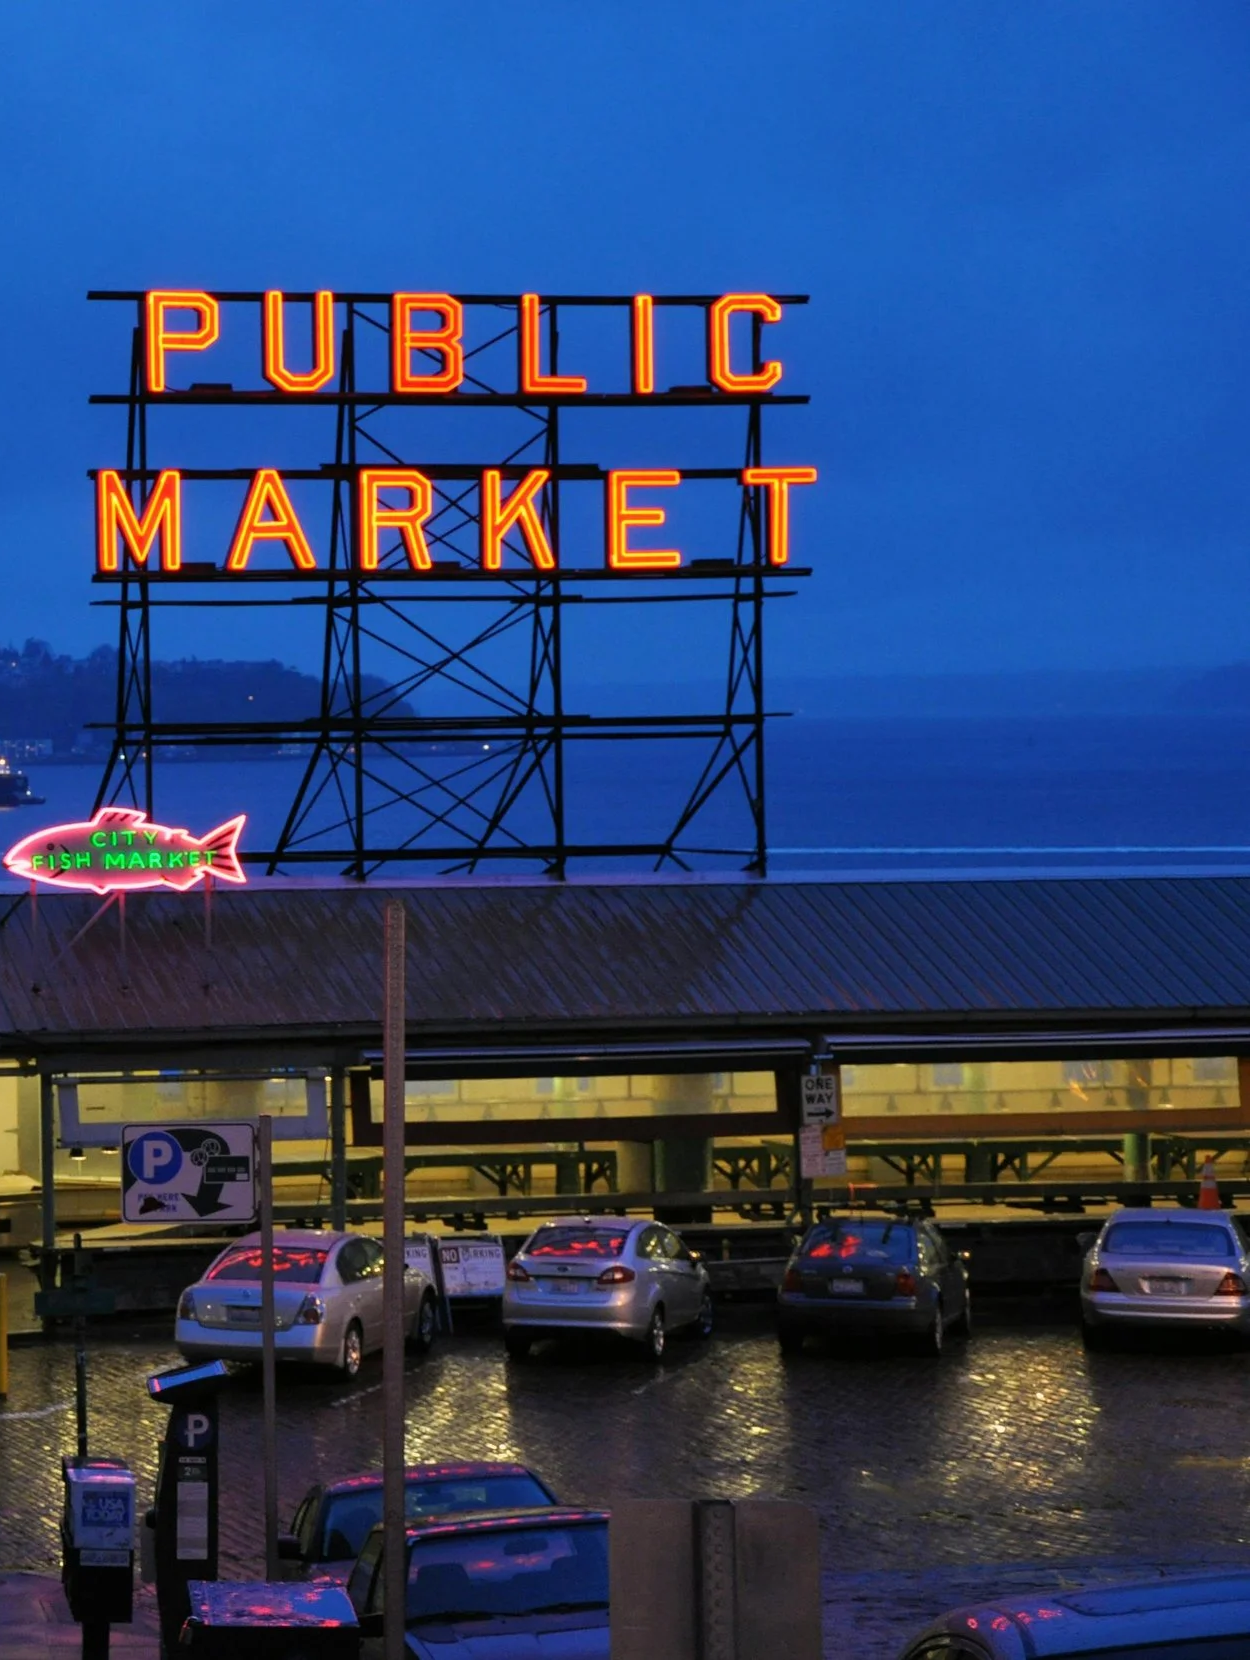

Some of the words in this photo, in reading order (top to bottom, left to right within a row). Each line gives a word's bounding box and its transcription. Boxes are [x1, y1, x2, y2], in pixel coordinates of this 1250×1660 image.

[147, 291, 782, 394] PUBLIC
[98, 467, 817, 571] MARKET
[90, 831, 158, 847] CITY
[32, 852, 91, 870] FISH
[105, 851, 217, 870] MARKET
[805, 1077, 833, 1090] ONE
[806, 1093, 833, 1104] WAY
[143, 1140, 173, 1179] P
[442, 1248, 457, 1262] NO
[187, 1413, 209, 1448] P
[98, 1498, 124, 1511] USA
[85, 1508, 124, 1522] TODAY
